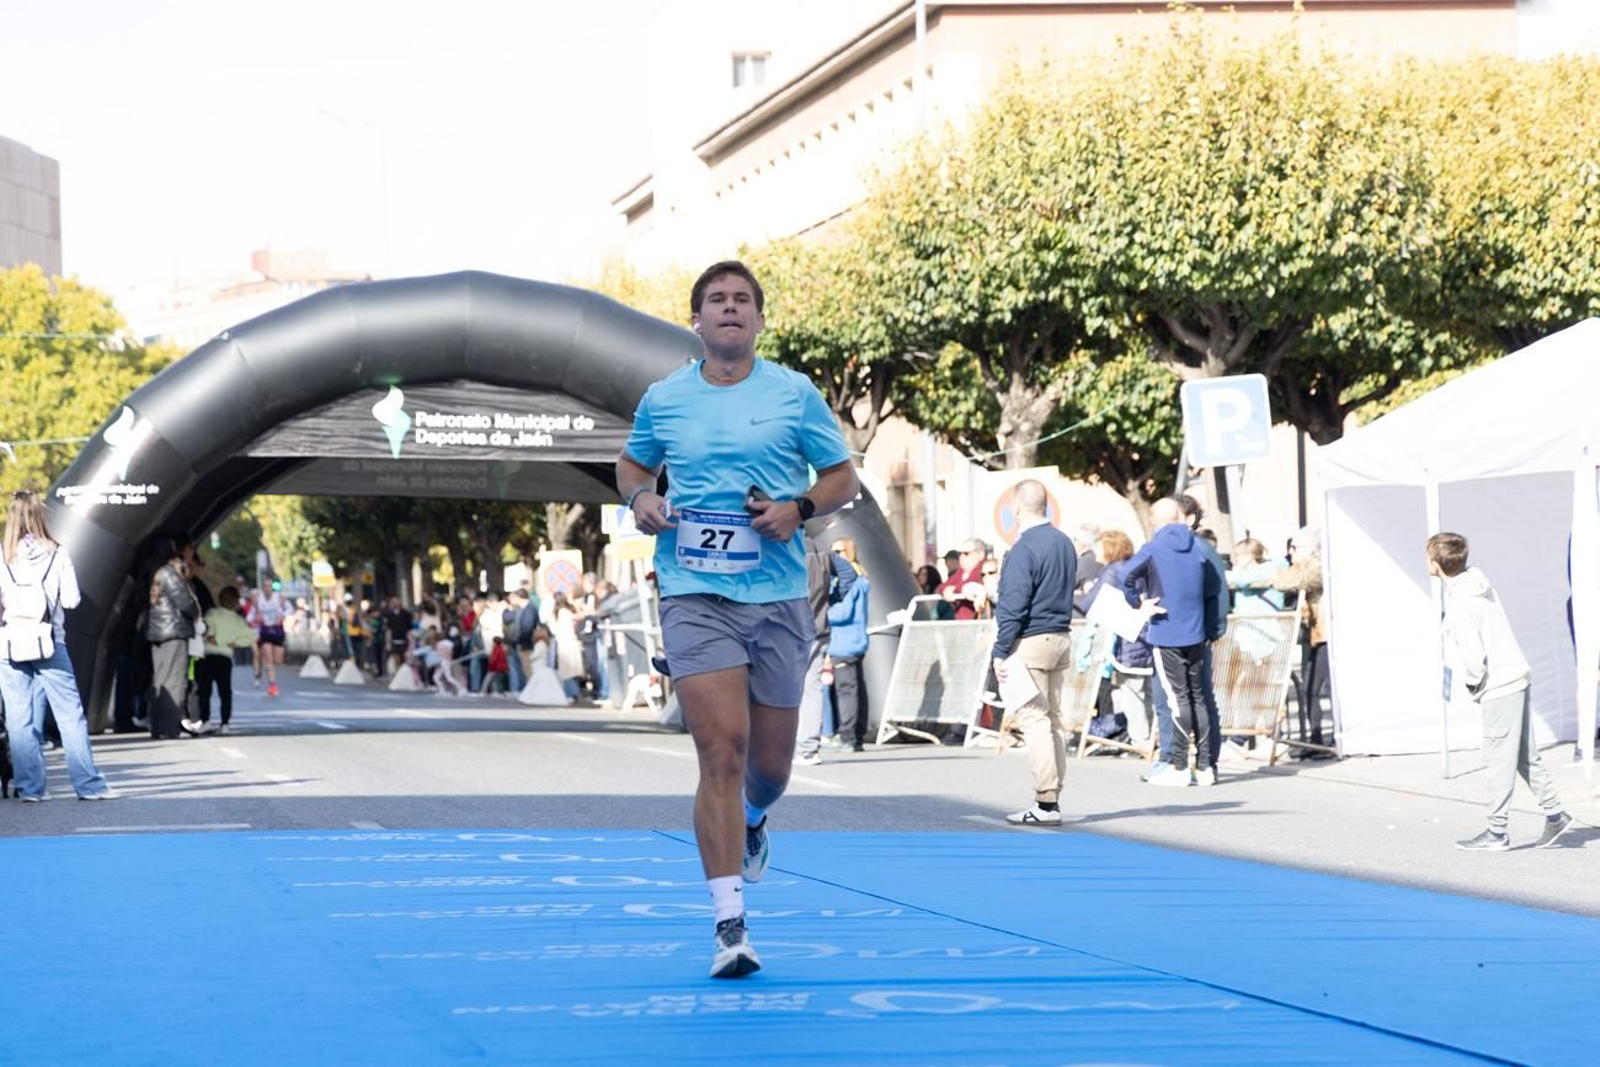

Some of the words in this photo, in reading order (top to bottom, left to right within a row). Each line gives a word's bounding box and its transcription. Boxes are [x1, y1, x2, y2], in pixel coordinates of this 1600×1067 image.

[415, 411, 492, 429] Patronato
[494, 413, 571, 434] Municipal
[573, 415, 595, 431] de
[1201, 388, 1252, 455] P
[415, 429, 488, 448] Deportes
[490, 430, 512, 446] de
[513, 430, 554, 447] Jaén
[700, 529, 735, 550] 27
